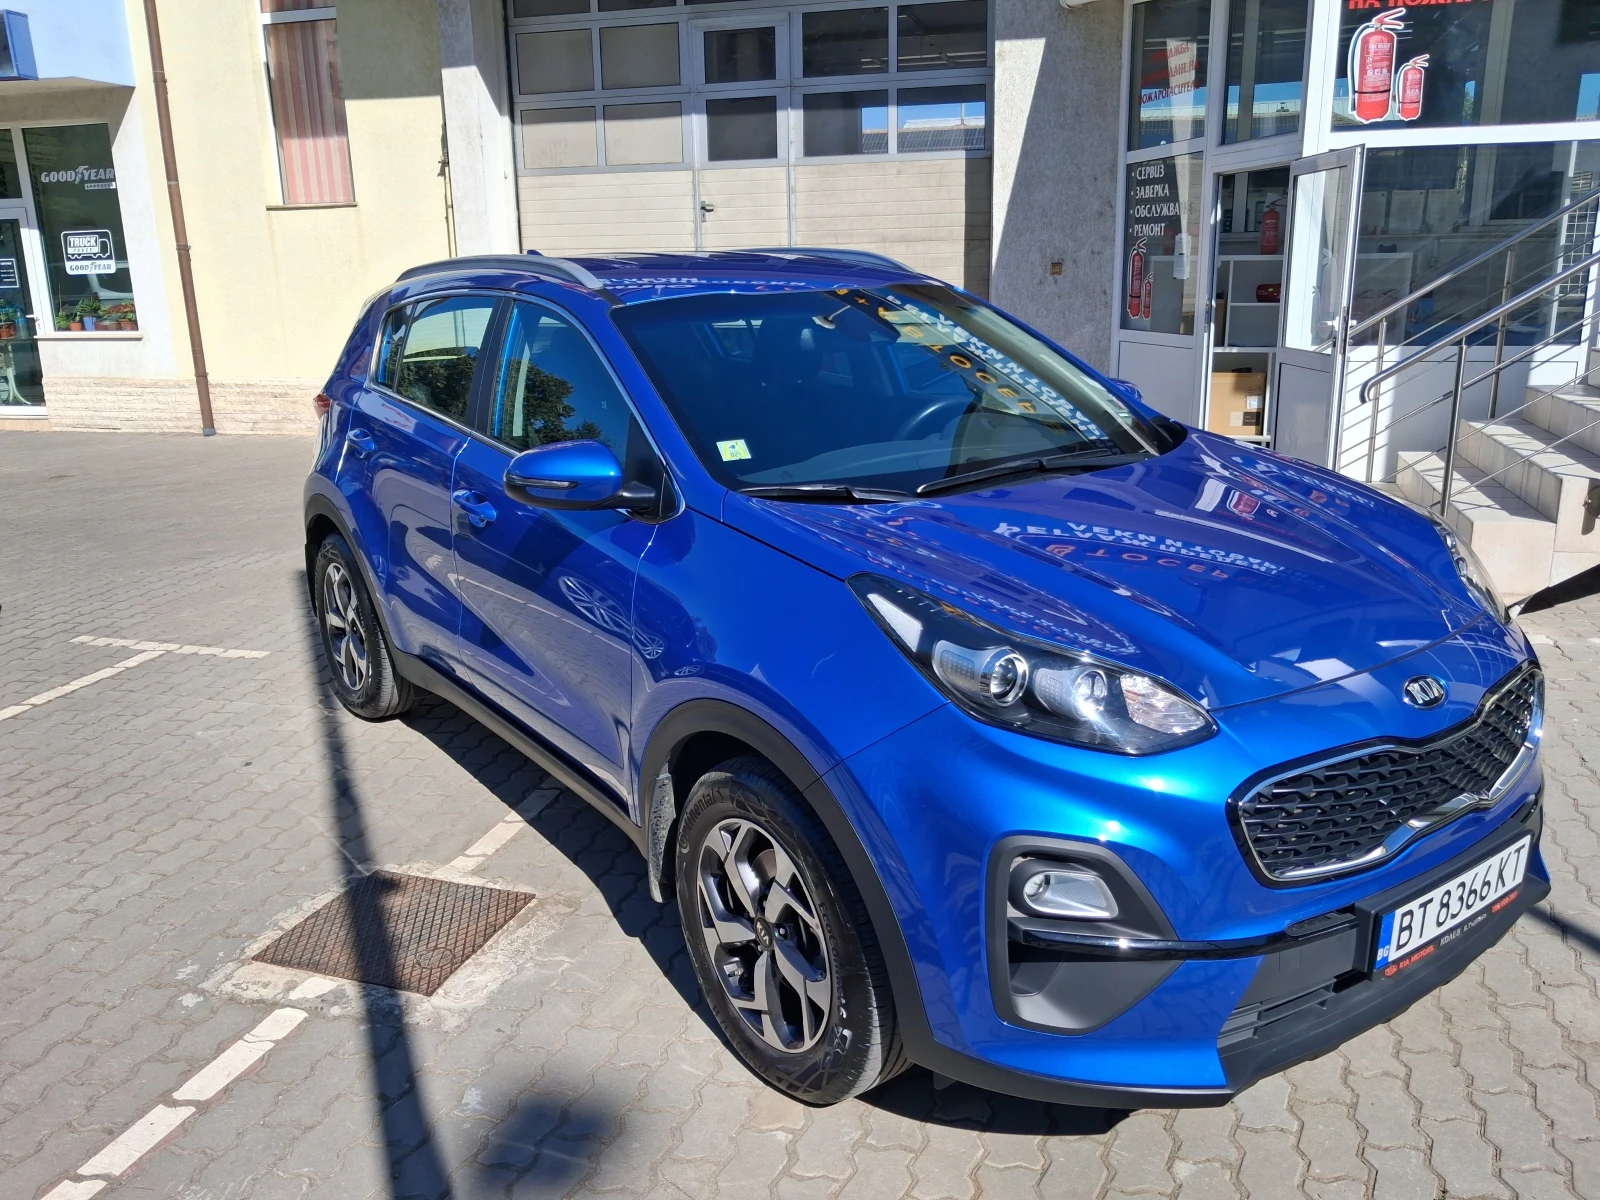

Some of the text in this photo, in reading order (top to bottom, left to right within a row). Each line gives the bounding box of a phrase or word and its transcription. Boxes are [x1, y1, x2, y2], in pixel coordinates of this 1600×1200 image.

[1136, 165, 1165, 180] СЕРВИЗ
[1135, 184, 1169, 199] ЗАВЕРКА
[1134, 223, 1166, 237] РЕМОНТ
[70, 237, 97, 248] TRUCK
[1395, 843, 1526, 953] BT 8366 KT
[1377, 945, 1390, 961] BG
